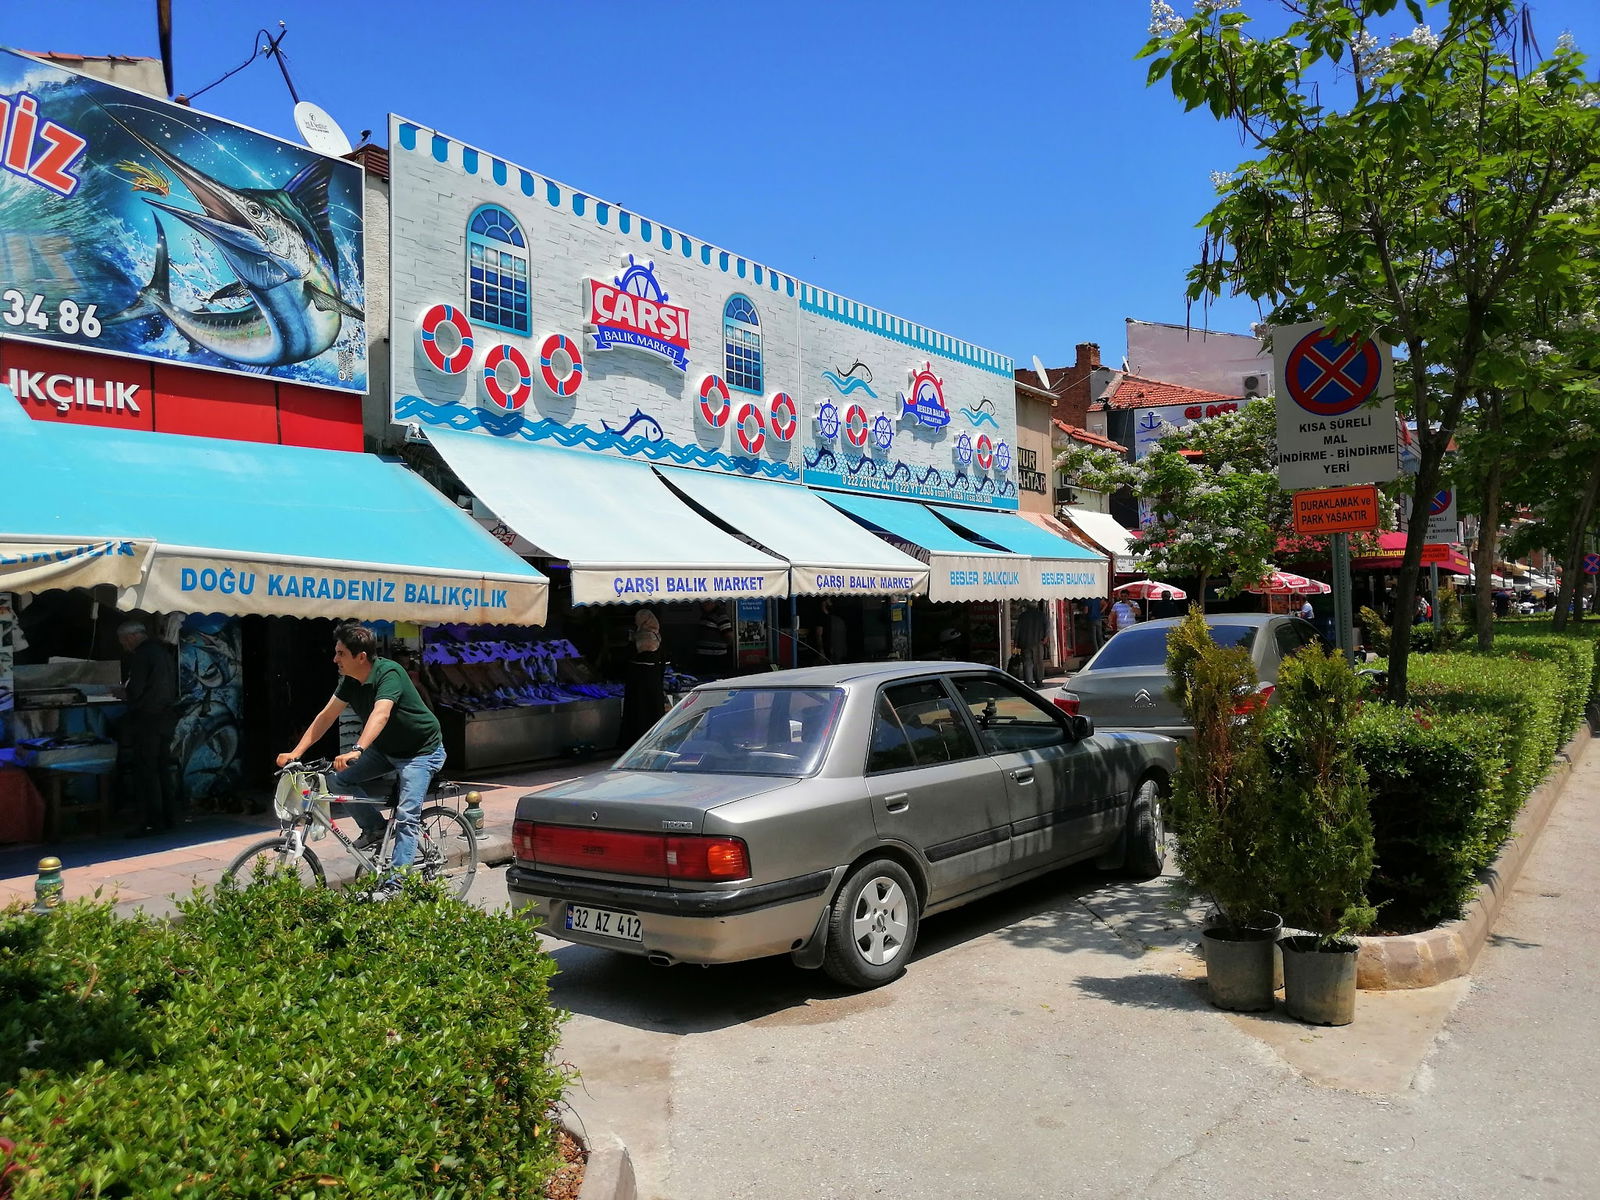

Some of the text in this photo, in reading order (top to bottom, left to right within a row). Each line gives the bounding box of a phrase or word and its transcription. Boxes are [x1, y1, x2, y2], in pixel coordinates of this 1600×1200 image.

[0, 94, 87, 194] İZ
[2, 289, 102, 338] 34 86
[594, 286, 688, 340] ÇARŞI
[604, 330, 679, 359] BALIK MARKET
[1299, 414, 1372, 433] KISA SÜRELİ
[1323, 434, 1348, 445] MAL
[1279, 450, 1327, 464] İNDİRME
[1337, 444, 1396, 459] BİNDİRME
[1323, 460, 1350, 474] YERİ
[1300, 496, 1371, 512] DURAKLAMAK ve
[1301, 510, 1367, 525] PARK YASAKTIR
[613, 576, 764, 596] ÇARŞI BALIK MARKET
[816, 574, 914, 590] ÇARŞI BALIK MARKET
[950, 571, 979, 586] BESLER
[1041, 572, 1065, 585] BESLER
[180, 567, 508, 610] DOĞU KARADENİZ BALIKÇILIK
[574, 908, 642, 939] 32 AZ 412
